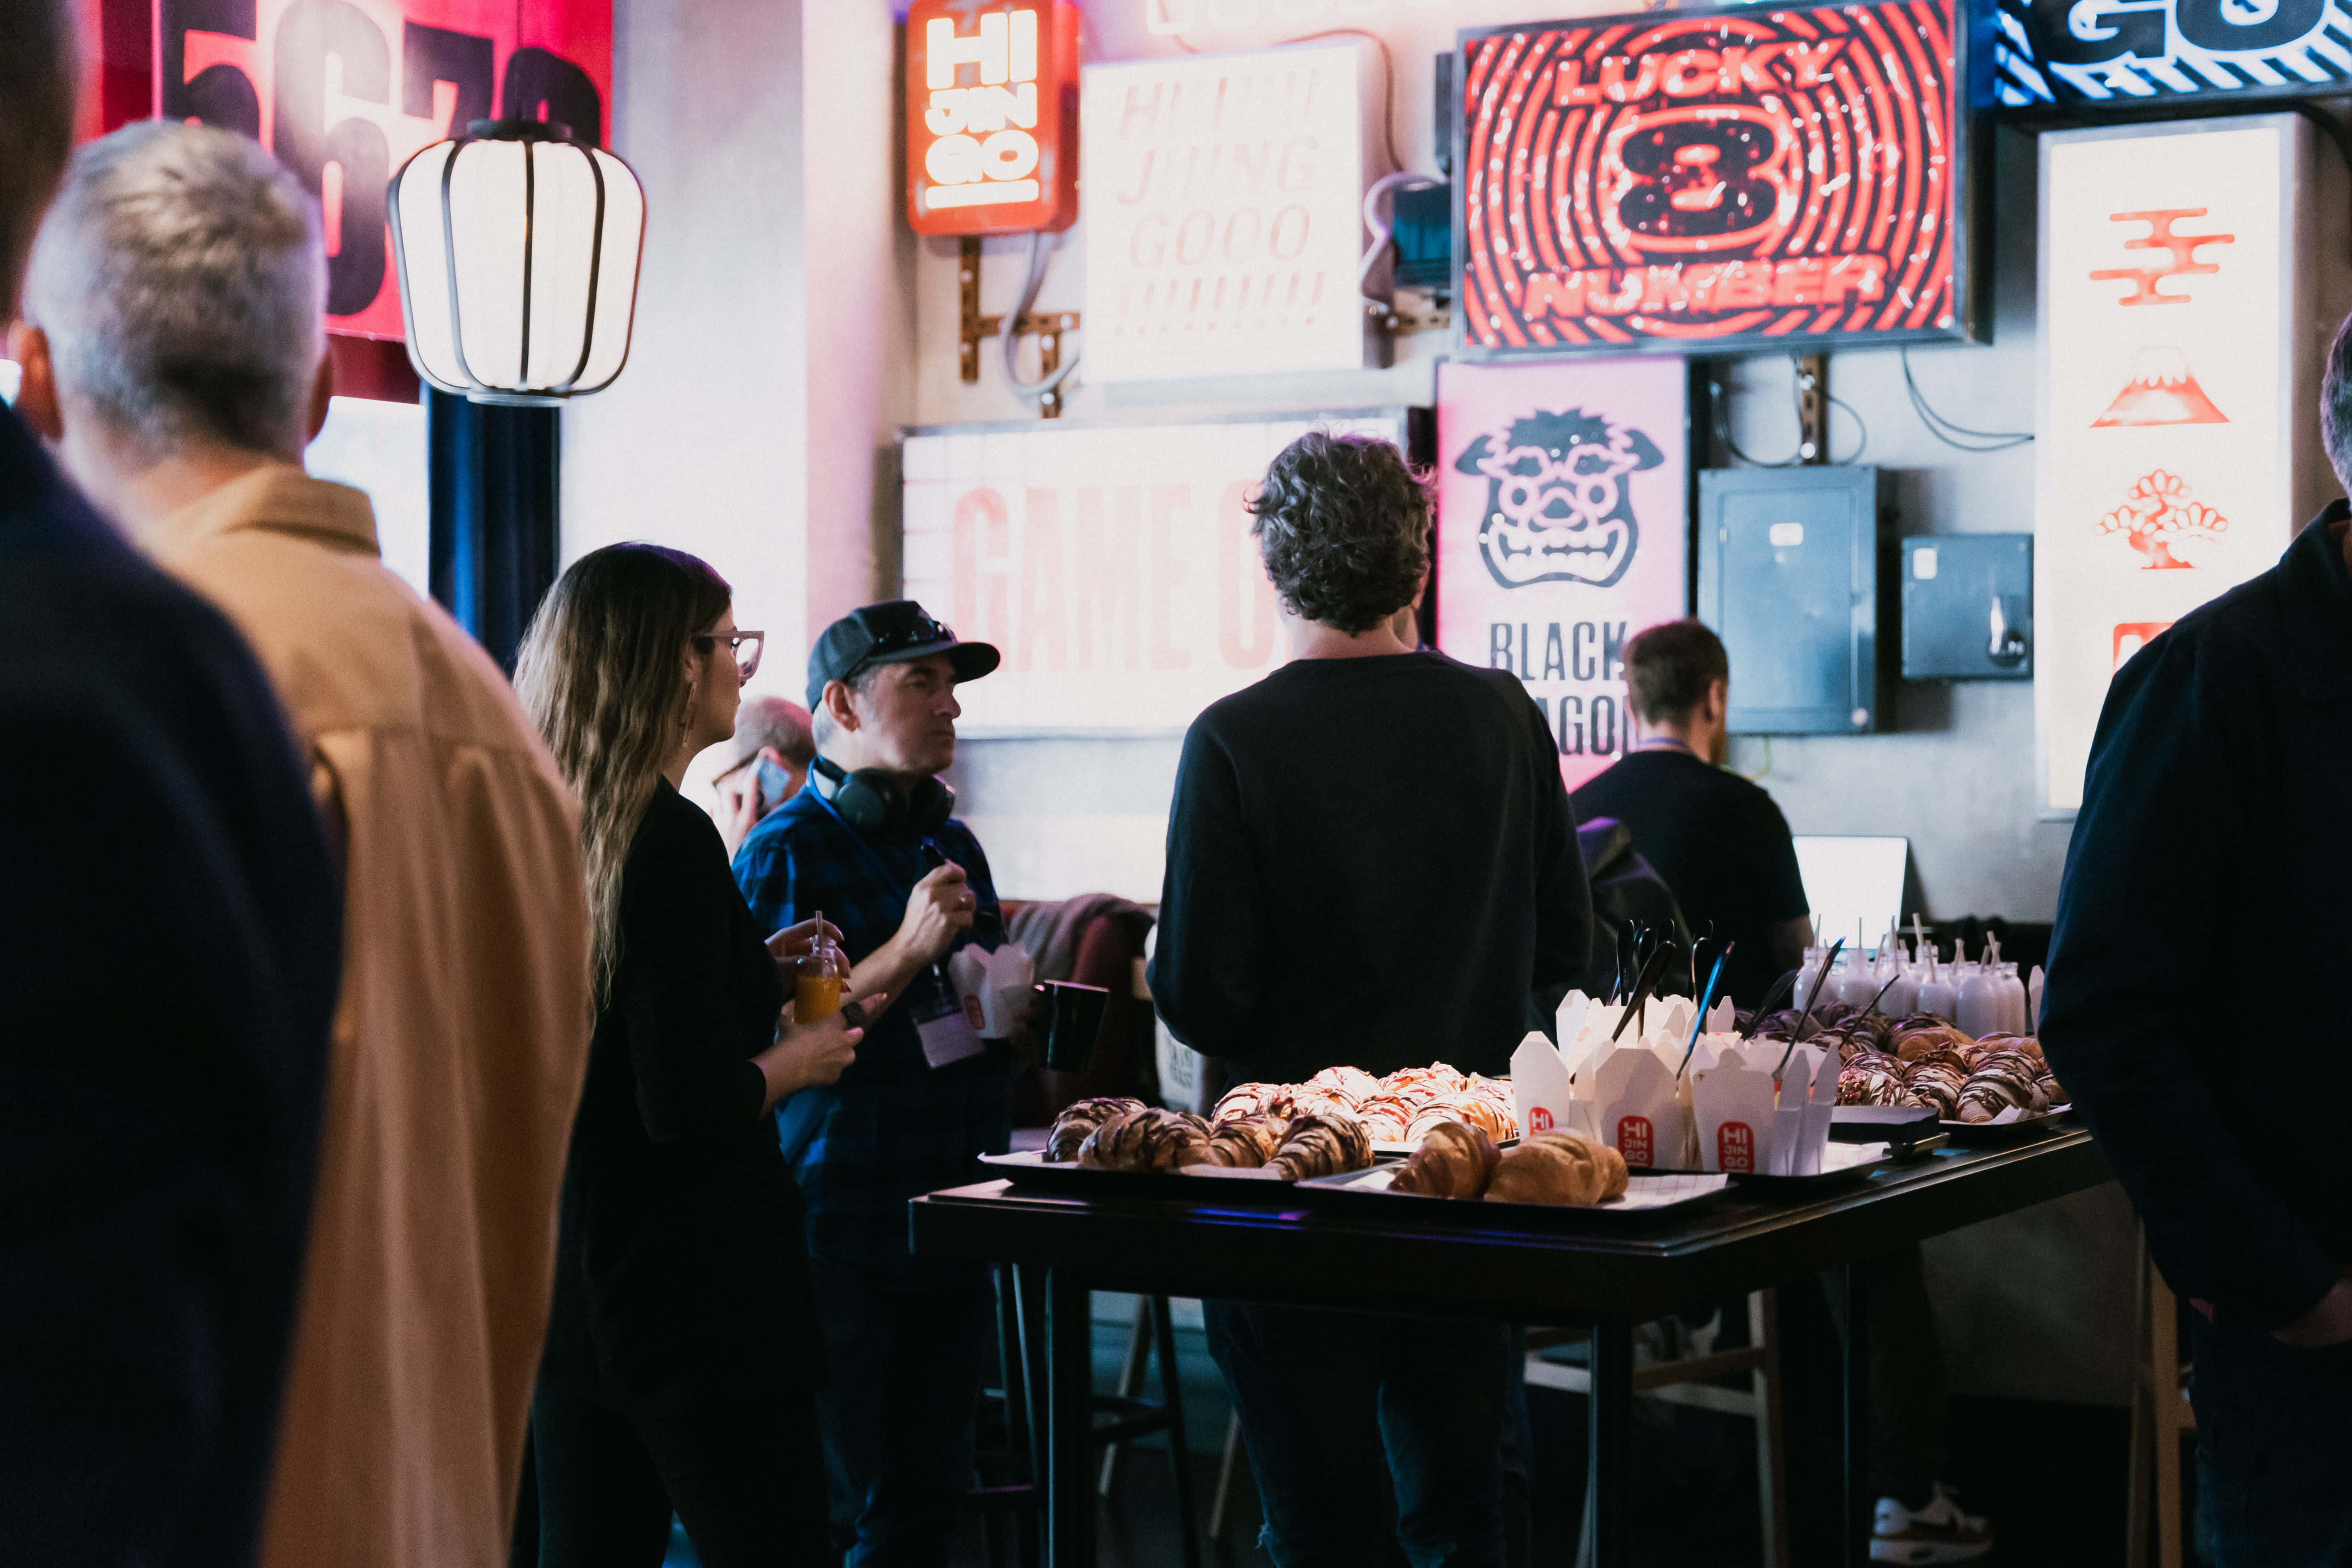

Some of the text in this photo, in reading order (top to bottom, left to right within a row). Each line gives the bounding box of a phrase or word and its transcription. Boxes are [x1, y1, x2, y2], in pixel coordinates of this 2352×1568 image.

[926, 9, 1038, 90] HI
[1553, 38, 1846, 107] LUCKY
[925, 82, 1038, 136] JIN
[925, 129, 1039, 185] GO
[1613, 112, 1782, 243] 8
[1129, 202, 1312, 270] GOOO
[1522, 254, 1888, 318] NUMBER
[953, 484, 1192, 673] GAME
[1490, 621, 1627, 681] BLACK
[1531, 1112, 1549, 1130] HI
[1623, 1121, 1647, 1138] HI
[1624, 1139, 1647, 1149] JIN
[1723, 1128, 1747, 1144] HI
